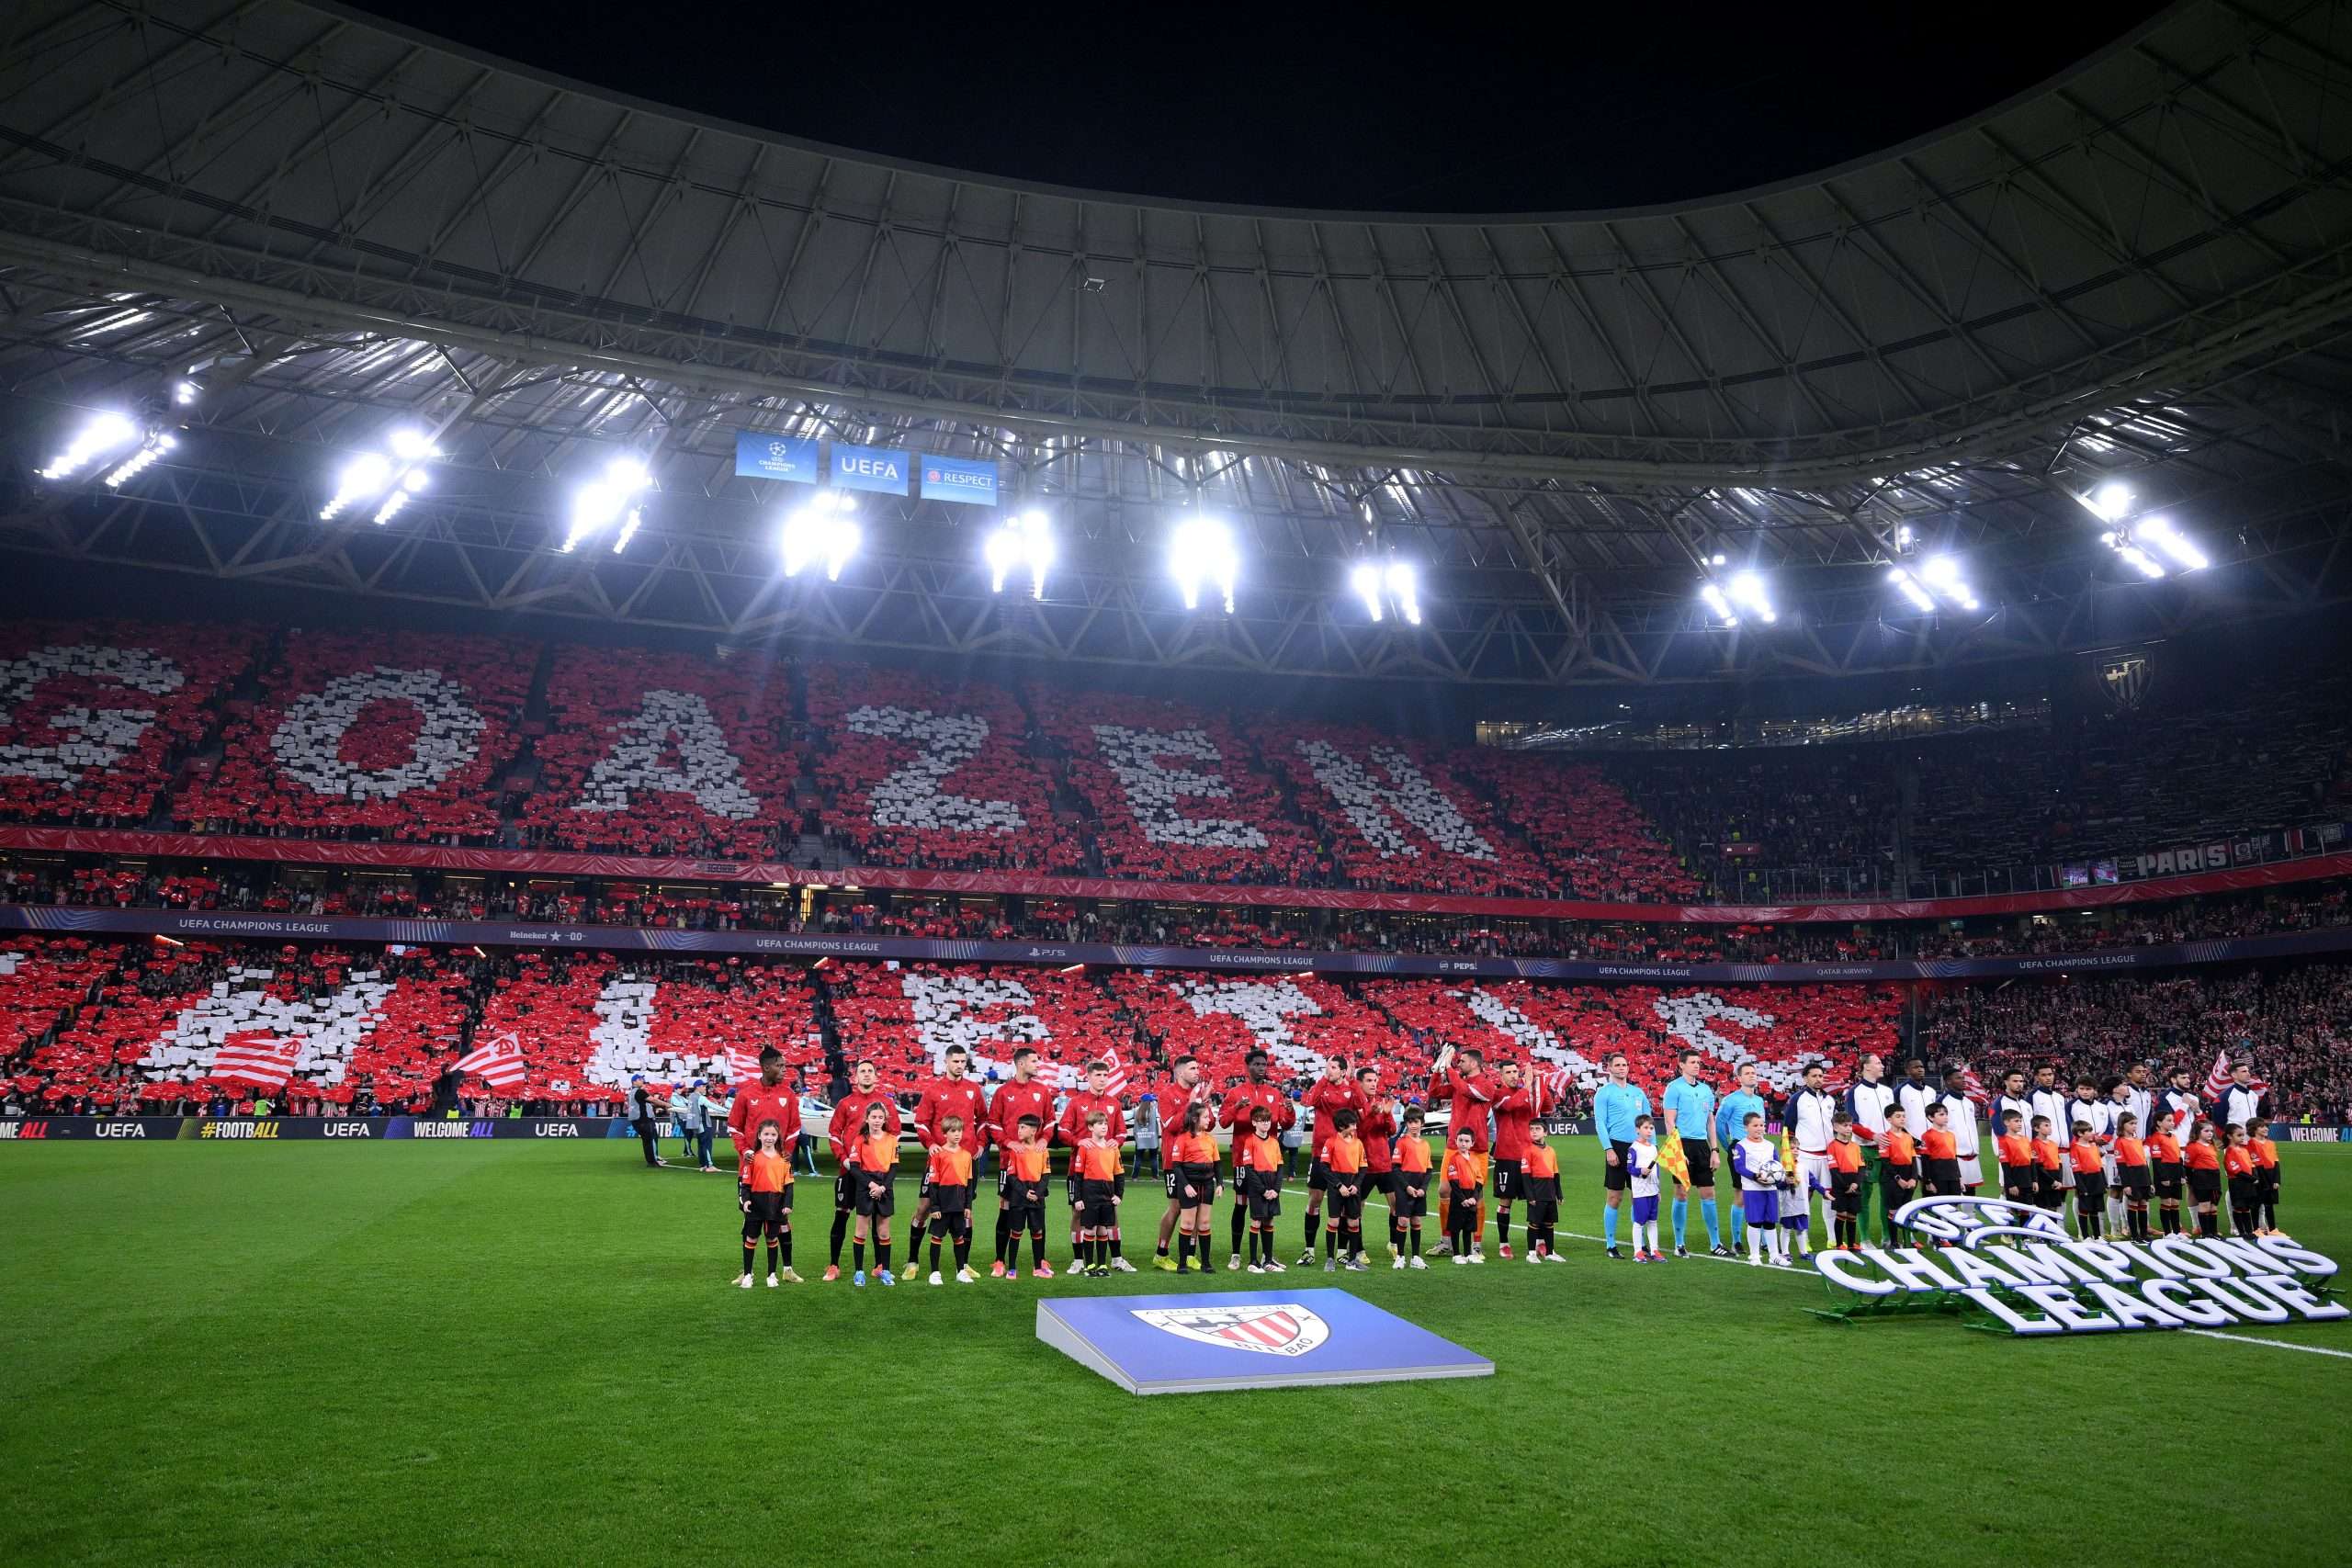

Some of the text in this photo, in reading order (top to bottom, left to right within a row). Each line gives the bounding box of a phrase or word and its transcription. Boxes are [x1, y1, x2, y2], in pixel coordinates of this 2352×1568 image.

[842, 457, 899, 479] UEFA
[944, 472, 993, 488] RESPECT
[2137, 845, 2227, 876] PARIS
[179, 919, 330, 932] UEFA CHAMPIONS LEAGUE
[510, 931, 547, 940] Heineken
[756, 939, 879, 952] UEFA CHAMPIONS LEAGUE
[1210, 954, 1315, 965] UEFA CHAMPIONS LEAGUE
[2019, 954, 2137, 969] UEFA CHAMPIONS LEAGUE
[1619, 967, 1660, 976] CHAMPIONS
[1663, 968, 1690, 976] LEAGUE
[19, 1122, 48, 1138] ALL
[96, 1123, 145, 1137] UEFA
[200, 1122, 279, 1138] #FOOTBALL
[323, 1122, 370, 1136] UEFA
[414, 1122, 494, 1137] WELCOME ALL
[535, 1123, 579, 1136] UEFA
[1549, 1123, 1578, 1134] UEFA
[1768, 1122, 1781, 1134] ALL
[2290, 1127, 2339, 1143] WELCOME
[1236, 1166, 1246, 1179] 19
[1498, 1172, 1508, 1184] 17
[1166, 1173, 1175, 1187] 12
[1912, 1202, 2073, 1241] UEFA
[1815, 1235, 2339, 1295] CHAMPIONS
[1961, 1274, 2350, 1334] LEAGUE
